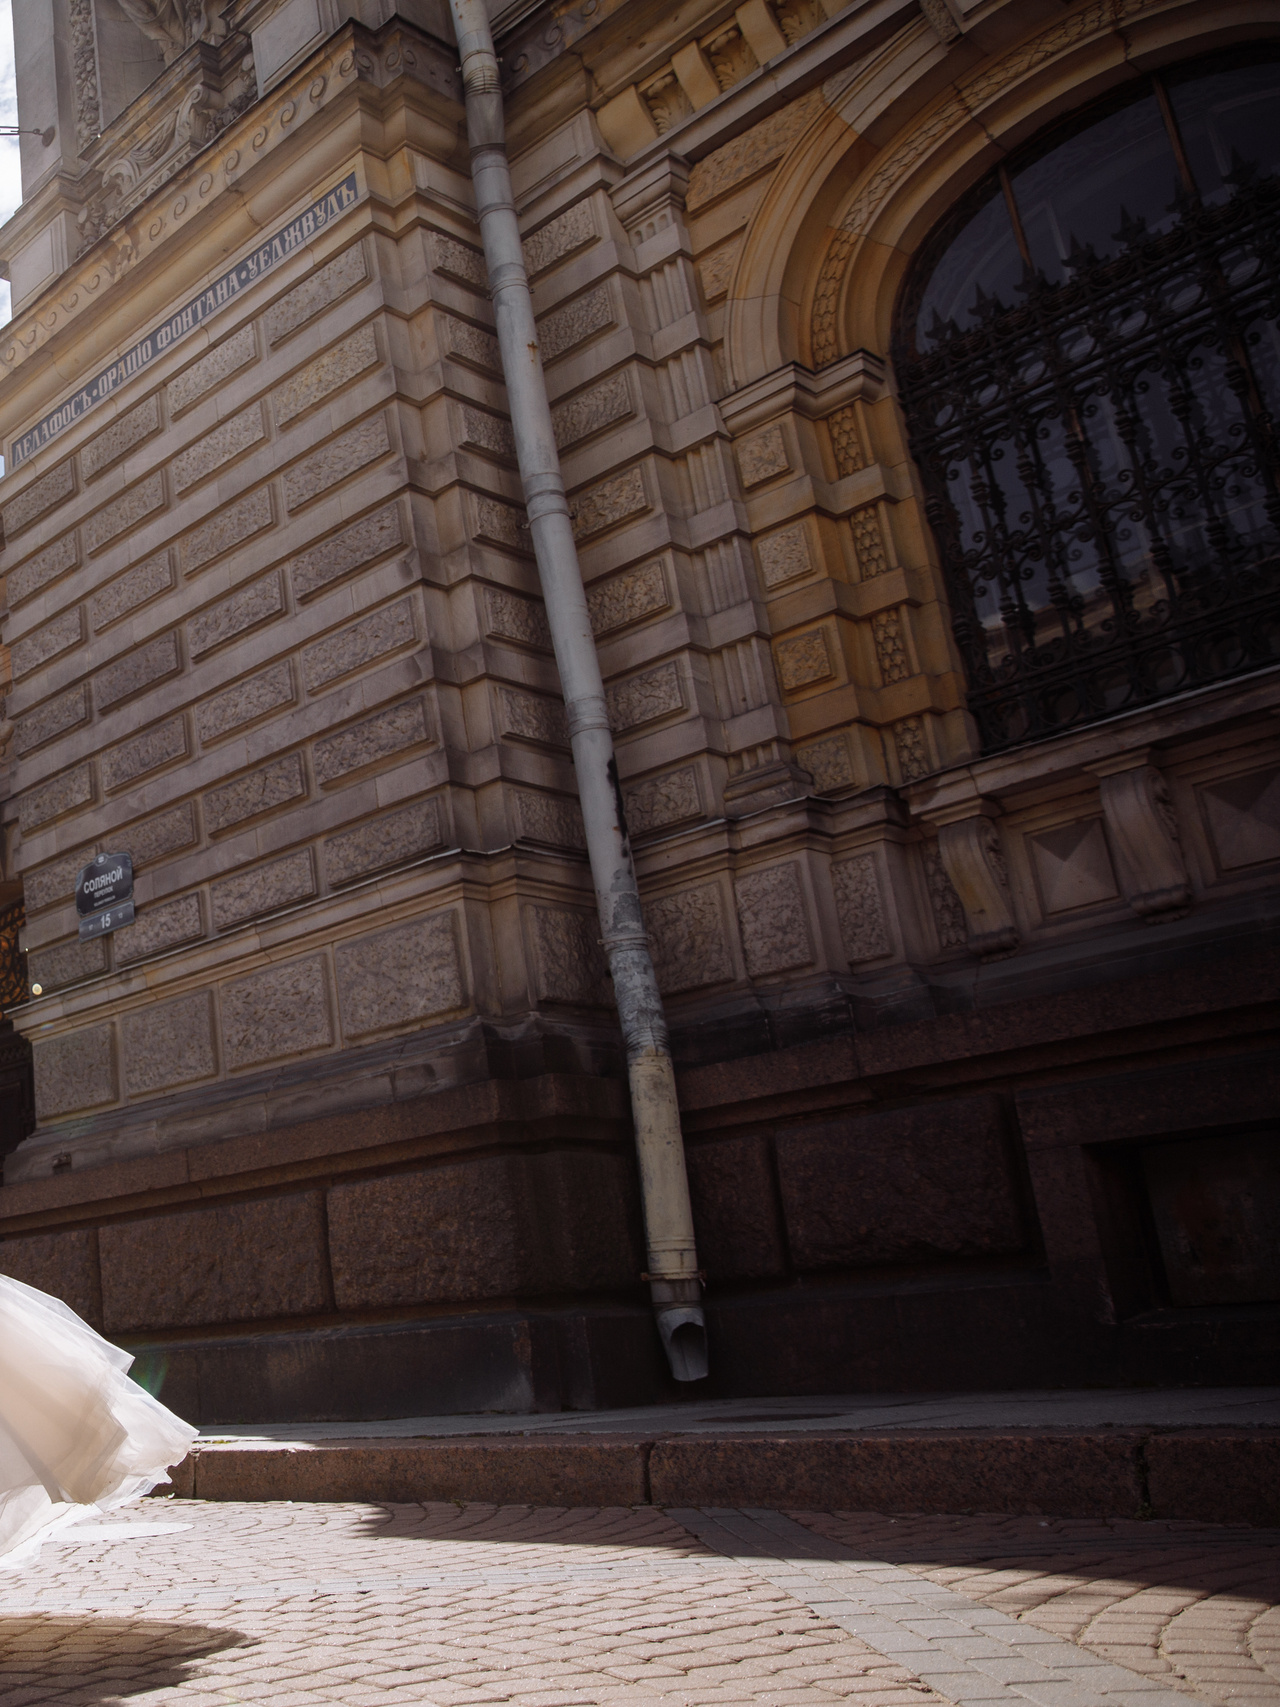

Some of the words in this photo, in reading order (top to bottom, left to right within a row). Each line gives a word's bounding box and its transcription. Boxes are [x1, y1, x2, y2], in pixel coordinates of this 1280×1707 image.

[156, 271, 240, 350] ФОНТАНА
[83, 865, 123, 894] СОЛЯНОЙ
[100, 913, 111, 929] 15
